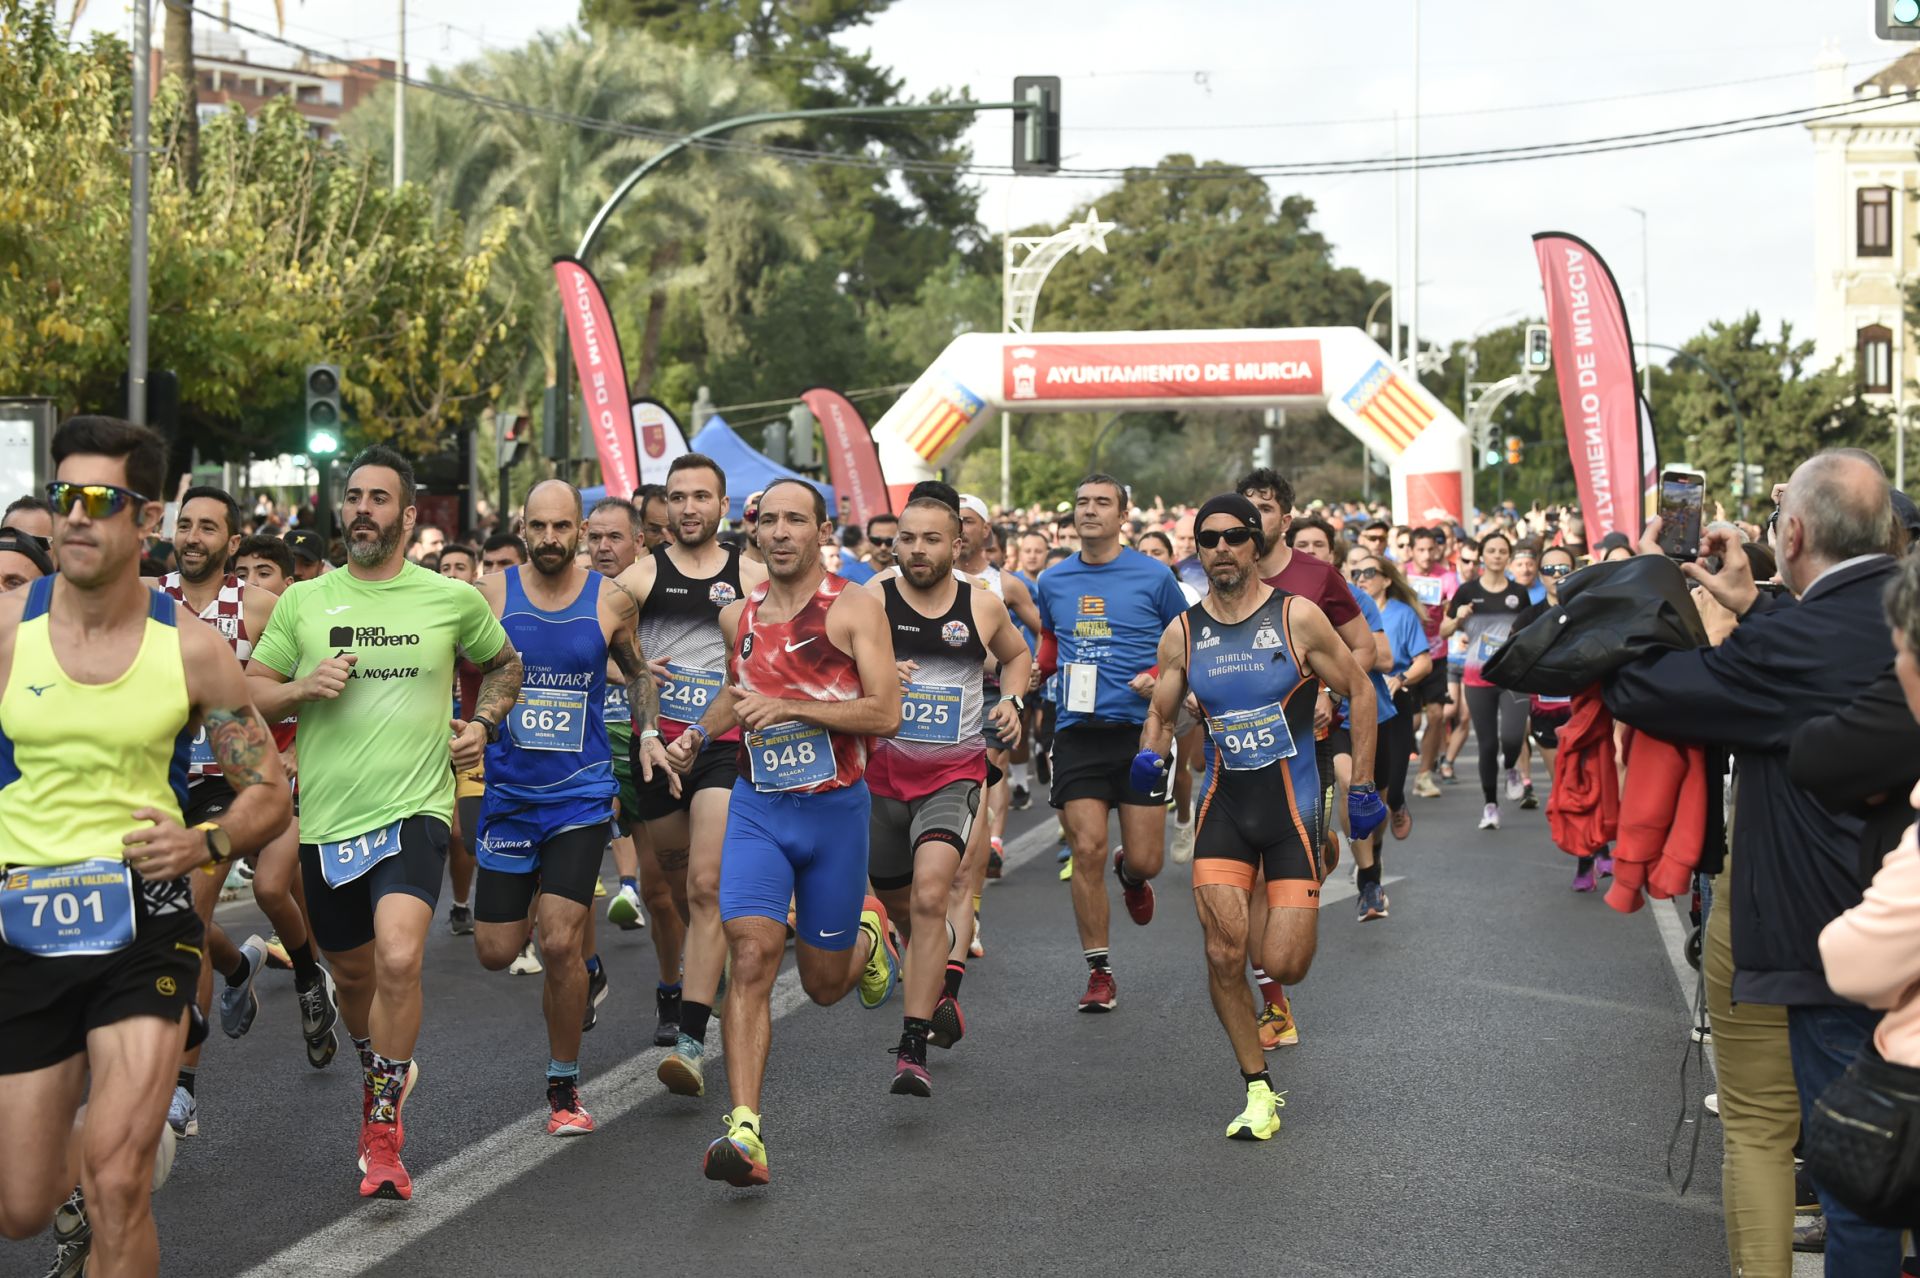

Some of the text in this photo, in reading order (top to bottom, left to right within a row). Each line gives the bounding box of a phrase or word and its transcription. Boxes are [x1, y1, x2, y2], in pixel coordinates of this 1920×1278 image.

[1046, 361, 1312, 383] AYUNTAMIENTO DE MURCIA
[356, 626, 385, 640] pan
[358, 634, 420, 647] moreno
[1196, 636, 1221, 650] VIATOR
[1215, 650, 1253, 664] TRIATLÓN
[363, 667, 419, 680] NOGALTE
[1208, 663, 1265, 677] TRAGAMILLAS
[696, 678, 720, 687] VALENCIA
[660, 681, 708, 707] 248
[937, 695, 960, 703] VALENCIA
[559, 701, 583, 709] VALENCIA
[902, 701, 949, 724] 025
[521, 709, 571, 732] 662
[1254, 714, 1281, 727] VALENCIA
[796, 728, 824, 740] VALENCIA
[1224, 727, 1275, 754] 945
[763, 742, 816, 771] 948
[338, 828, 388, 863] 514
[73, 876, 79, 887] X
[82, 873, 124, 885] VALENCIA
[23, 891, 104, 927] 701
[58, 928, 81, 936] KIKO
